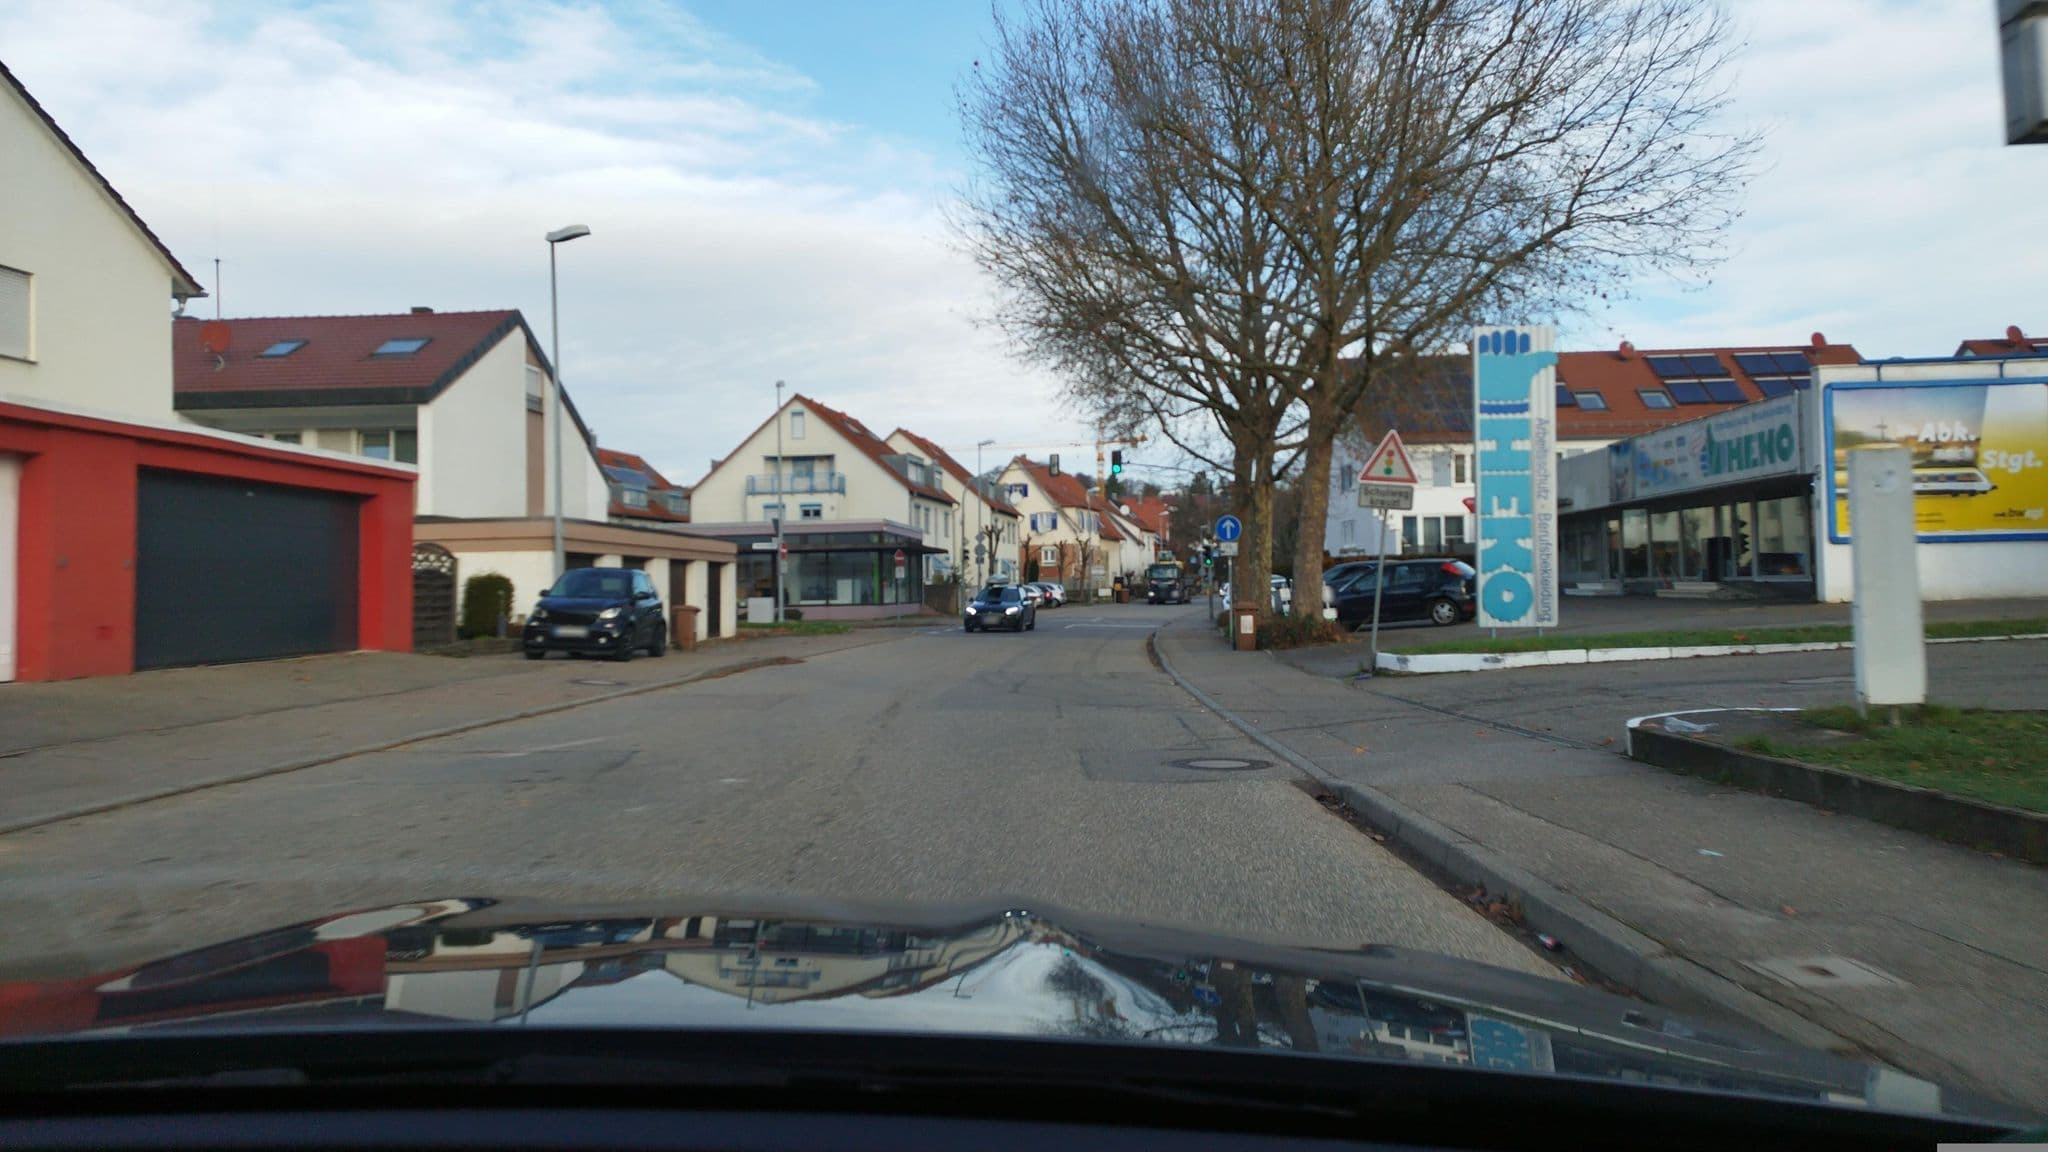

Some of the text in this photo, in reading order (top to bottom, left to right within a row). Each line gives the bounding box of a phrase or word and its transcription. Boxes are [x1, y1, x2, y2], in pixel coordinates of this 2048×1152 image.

[1918, 421, 1977, 442] Abk.
[1981, 449, 2043, 473] Stgt.
[1480, 418, 1534, 622] HEKO
[1537, 513, 1552, 622] Berufsbekleidung
